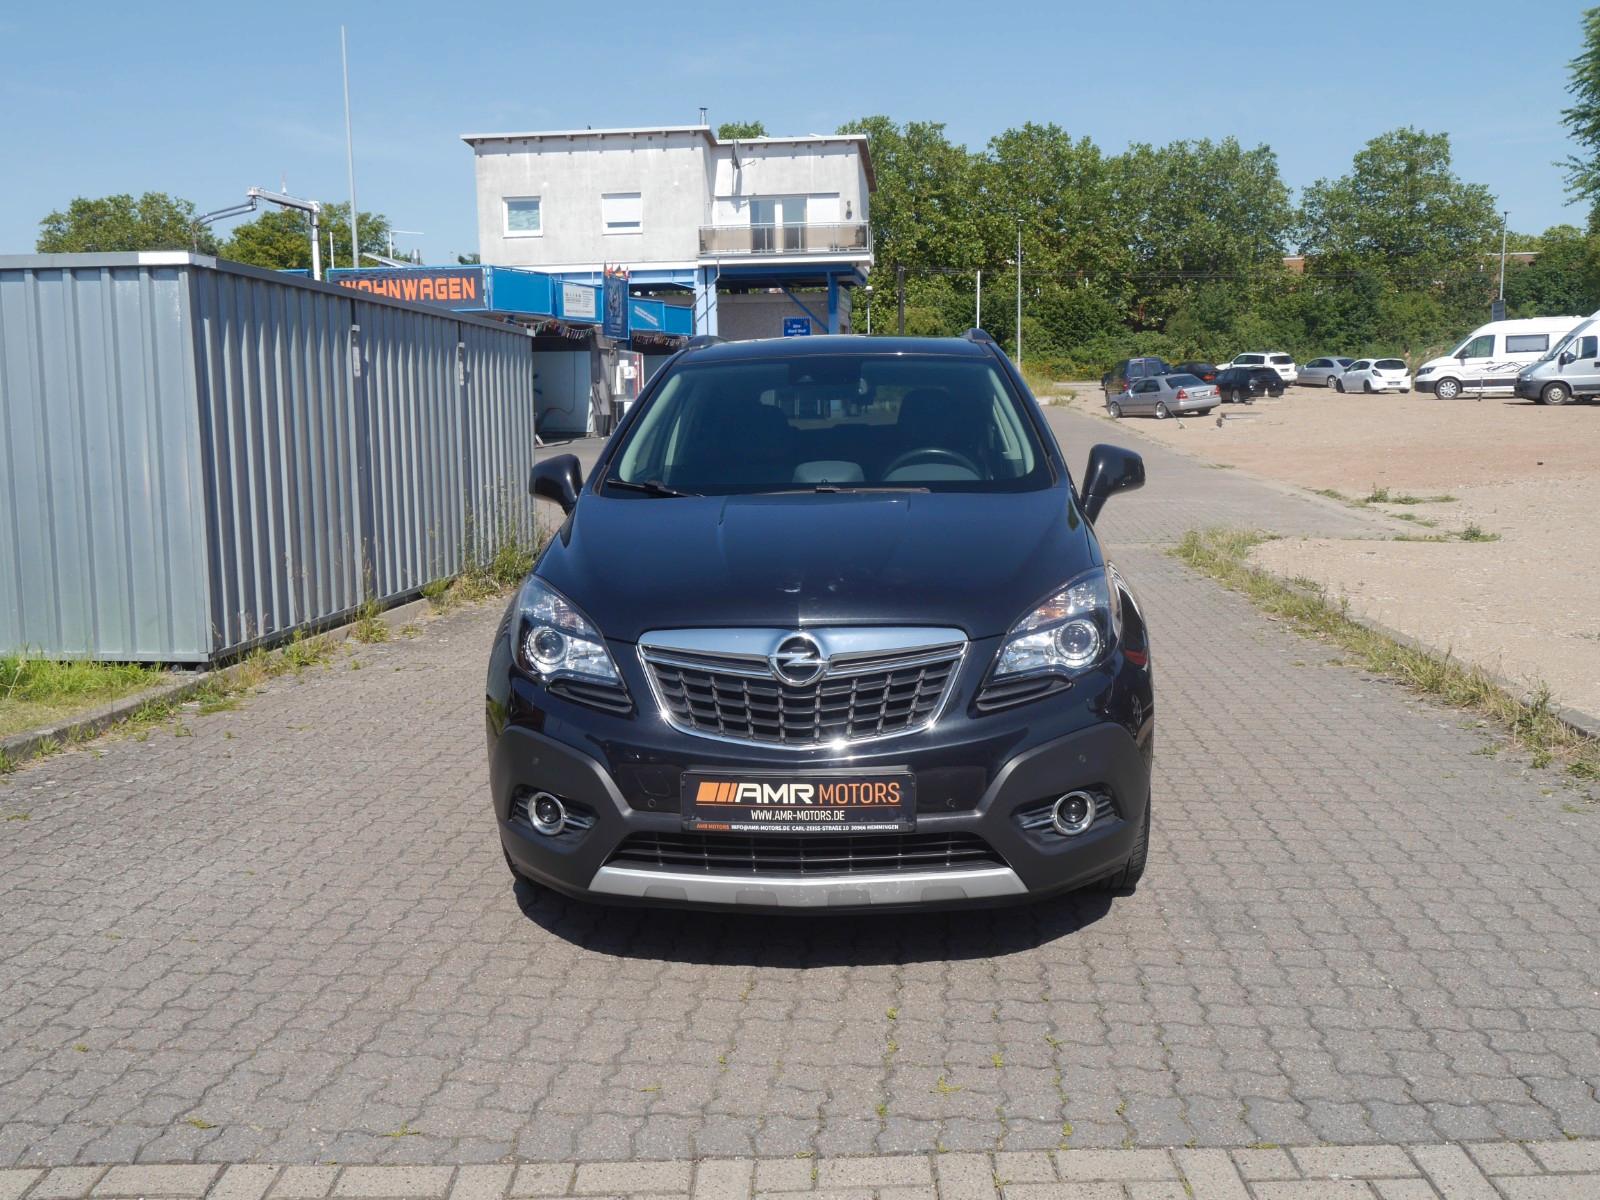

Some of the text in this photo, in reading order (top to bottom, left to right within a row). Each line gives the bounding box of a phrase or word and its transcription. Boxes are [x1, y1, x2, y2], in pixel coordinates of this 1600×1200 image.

[735, 782, 901, 804] AMR MOTORS
[751, 809, 845, 821] WWW.AMR-MOTORS.DE
